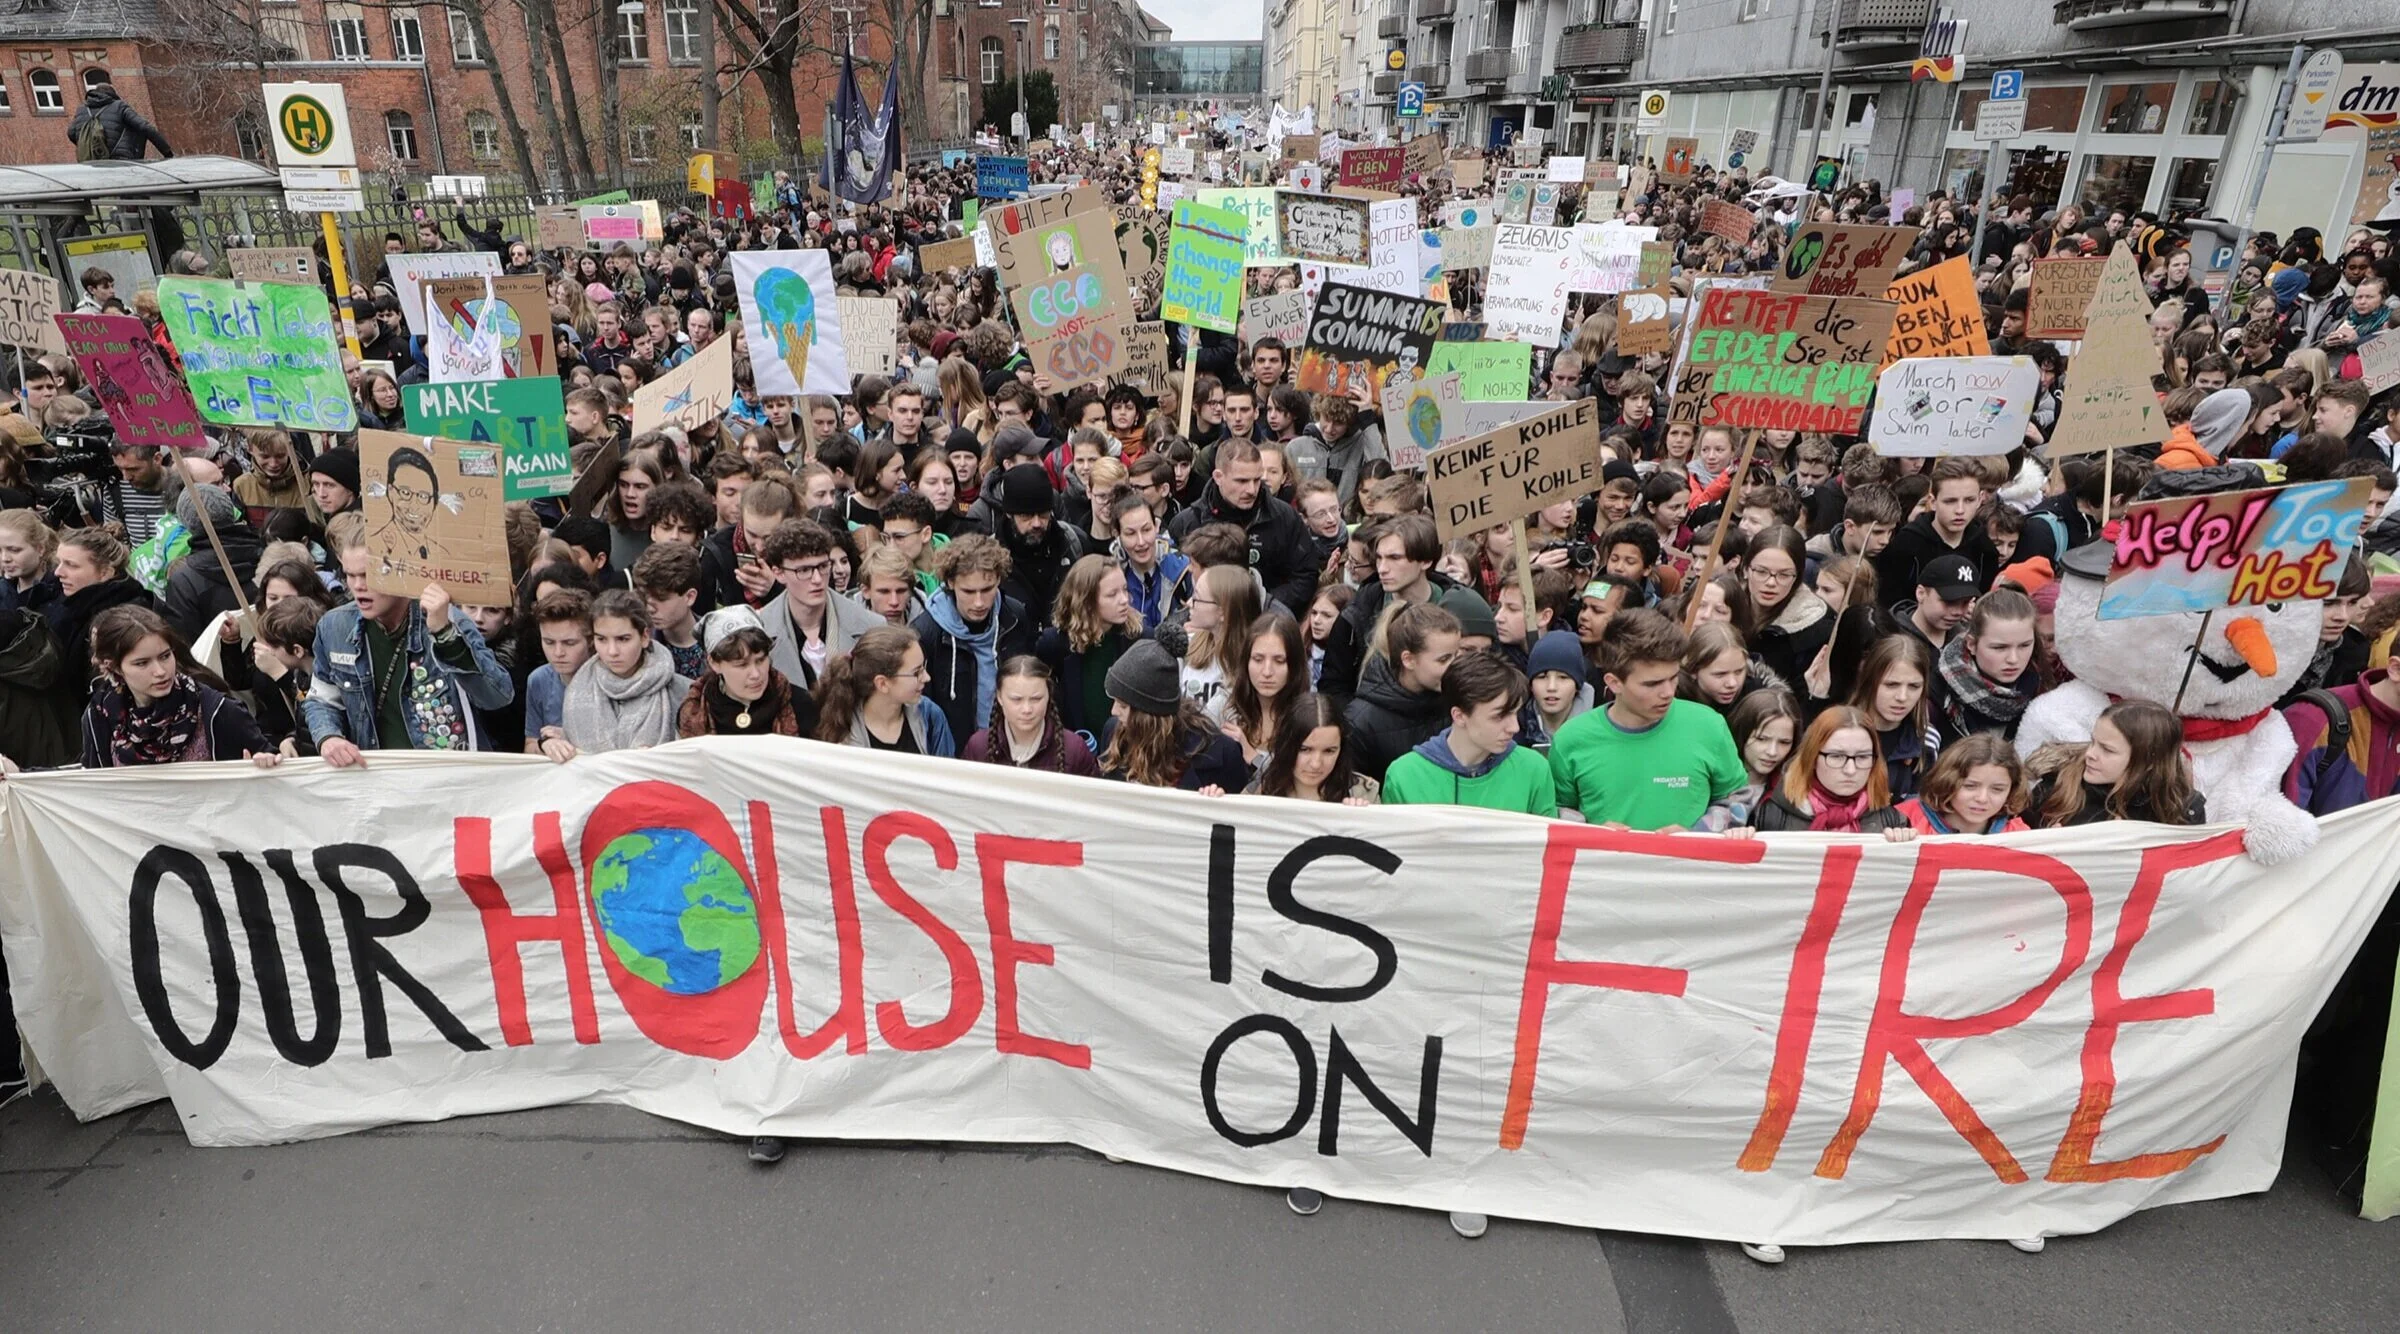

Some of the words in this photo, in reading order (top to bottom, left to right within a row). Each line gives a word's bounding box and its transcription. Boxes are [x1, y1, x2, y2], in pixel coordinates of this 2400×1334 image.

[1923, 7, 1957, 57] dm
[2320, 54, 2331, 65] 21
[1405, 91, 1415, 107] P
[1995, 74, 2013, 97] P
[2338, 75, 2400, 111] dm
[1651, 99, 1659, 110] H
[290, 109, 317, 140] H
[1349, 151, 1379, 160] WOLLT
[1384, 149, 1400, 159] IHR
[1349, 160, 1389, 177] LEBEN
[983, 176, 1020, 187] SCHULE
[1117, 206, 1153, 223] SOLAR
[1371, 224, 1416, 247] HOTTER
[1498, 225, 1573, 250] ZEUGNIS
[1173, 241, 1242, 284] change
[1559, 256, 1570, 269] 6
[1818, 232, 1850, 270] Es
[1853, 232, 1897, 275] gibt
[2216, 247, 2233, 268] P
[1171, 264, 1202, 290] the
[1489, 272, 1511, 286] ETHIK
[1554, 281, 1565, 298] 6
[176, 291, 262, 340] Fickt
[1166, 288, 1223, 316] world
[1250, 299, 1271, 318] ES
[1319, 287, 1425, 333] SUMMER
[1420, 305, 1447, 337] IS
[1550, 303, 1560, 316] 6
[1700, 289, 1809, 334] RETTET
[1814, 298, 1856, 344] die
[2043, 297, 2073, 311] NUR
[1057, 316, 1085, 340] NOT
[1311, 318, 1406, 355] COMING
[1443, 322, 1484, 340] KIDS
[1690, 329, 1798, 366] ERDE!
[1784, 335, 1827, 366] Sie
[1841, 340, 1872, 364] ist
[1676, 366, 1713, 394] der
[1896, 363, 1956, 392] March
[1964, 368, 2012, 390] now
[207, 384, 241, 416] die
[247, 375, 350, 429] Erde
[419, 382, 502, 418] MAKE
[673, 389, 724, 431] STIK
[1387, 390, 1406, 412] ES
[1441, 379, 1460, 401] IST
[1936, 398, 1973, 416] or
[1672, 391, 1708, 425] mit
[1702, 392, 1864, 435] SCHOKOLADE
[1883, 408, 1930, 437] Swim
[1948, 415, 1995, 440] later
[439, 416, 566, 449] EARTH
[1433, 440, 1495, 480] KEINE
[1519, 404, 1592, 445] KOHLE
[505, 452, 568, 476] AGAIN
[1480, 447, 1541, 487] FÜR
[1450, 493, 1495, 527] DIE
[1523, 462, 1593, 500] KOHLE
[2115, 488, 2273, 571] Help!
[2228, 540, 2338, 604] Hot
[129, 841, 491, 1072] OUR
[453, 778, 1091, 1070] HOUSE
[1208, 823, 1402, 1002] IS
[1498, 824, 2250, 1185] FIRE
[1201, 1013, 1443, 1157] ON
